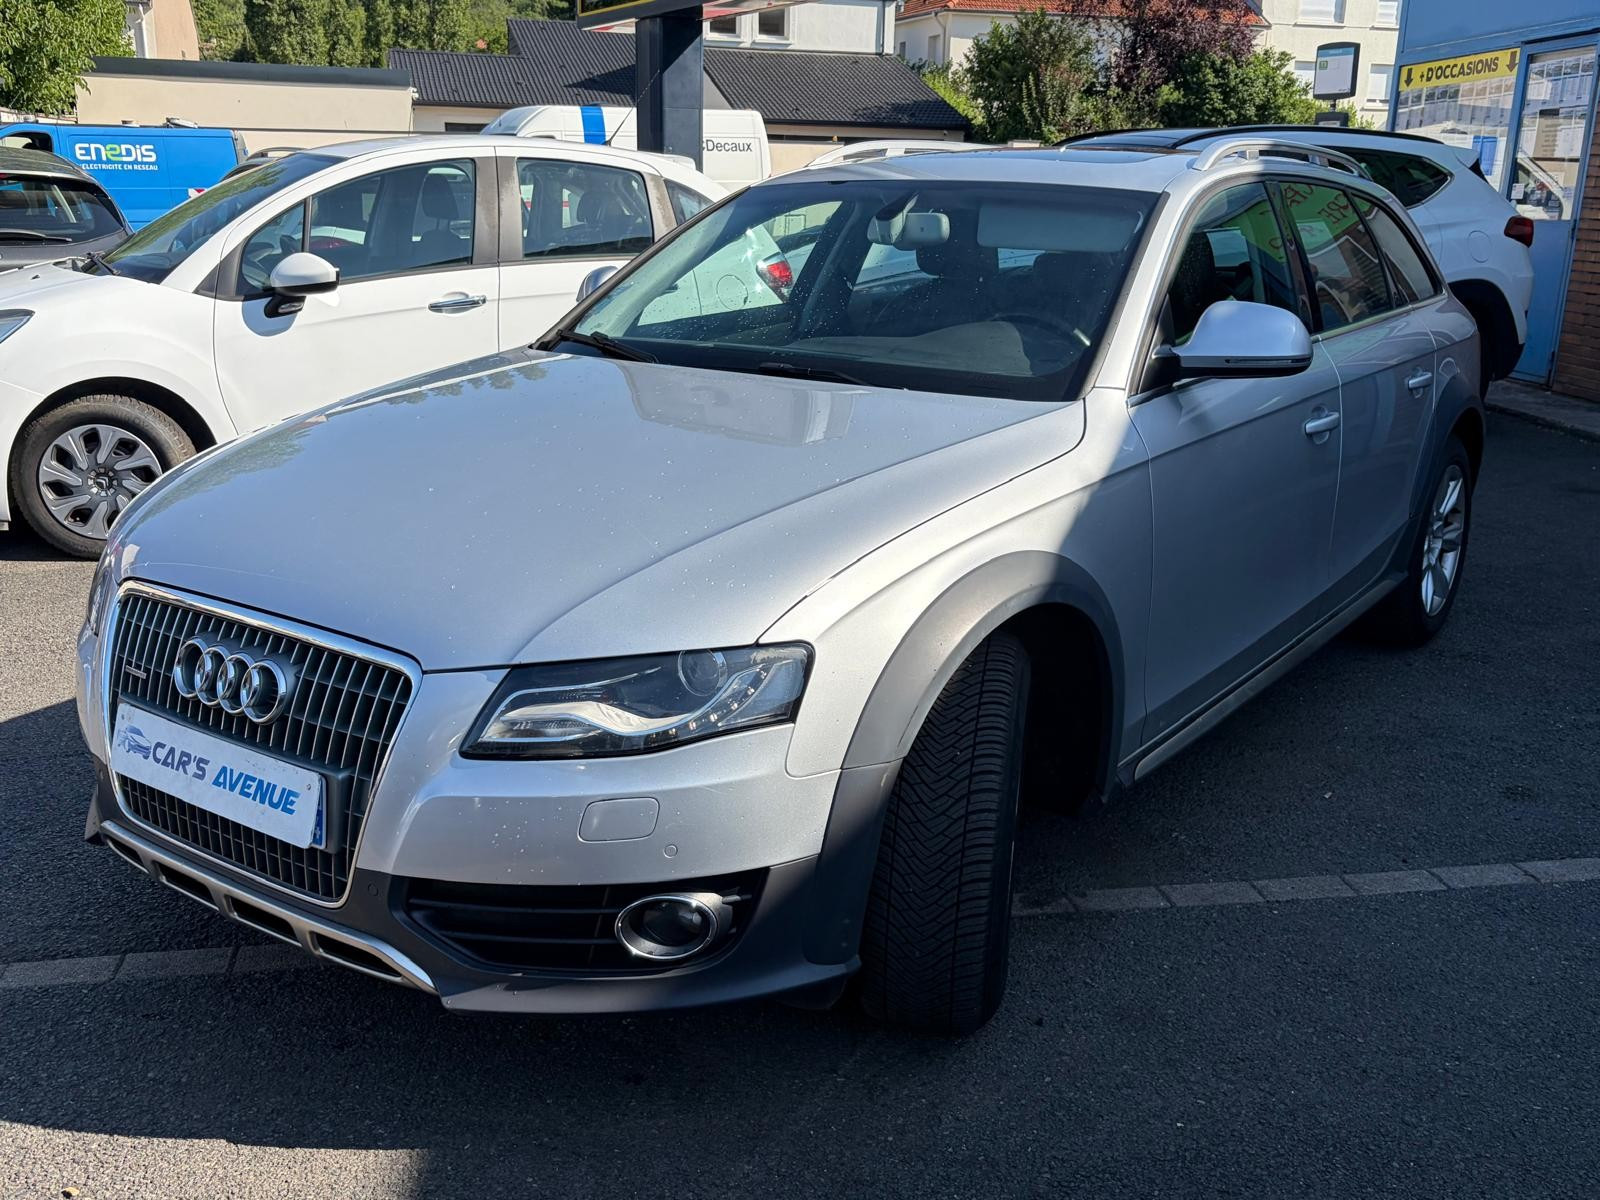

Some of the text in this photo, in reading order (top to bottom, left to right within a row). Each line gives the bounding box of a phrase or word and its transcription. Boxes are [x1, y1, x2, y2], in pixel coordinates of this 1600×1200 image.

[1426, 57, 1499, 82] D'OCCASIONS
[702, 139, 753, 152] Decaux
[152, 741, 301, 816] CAR'S AVENUE
